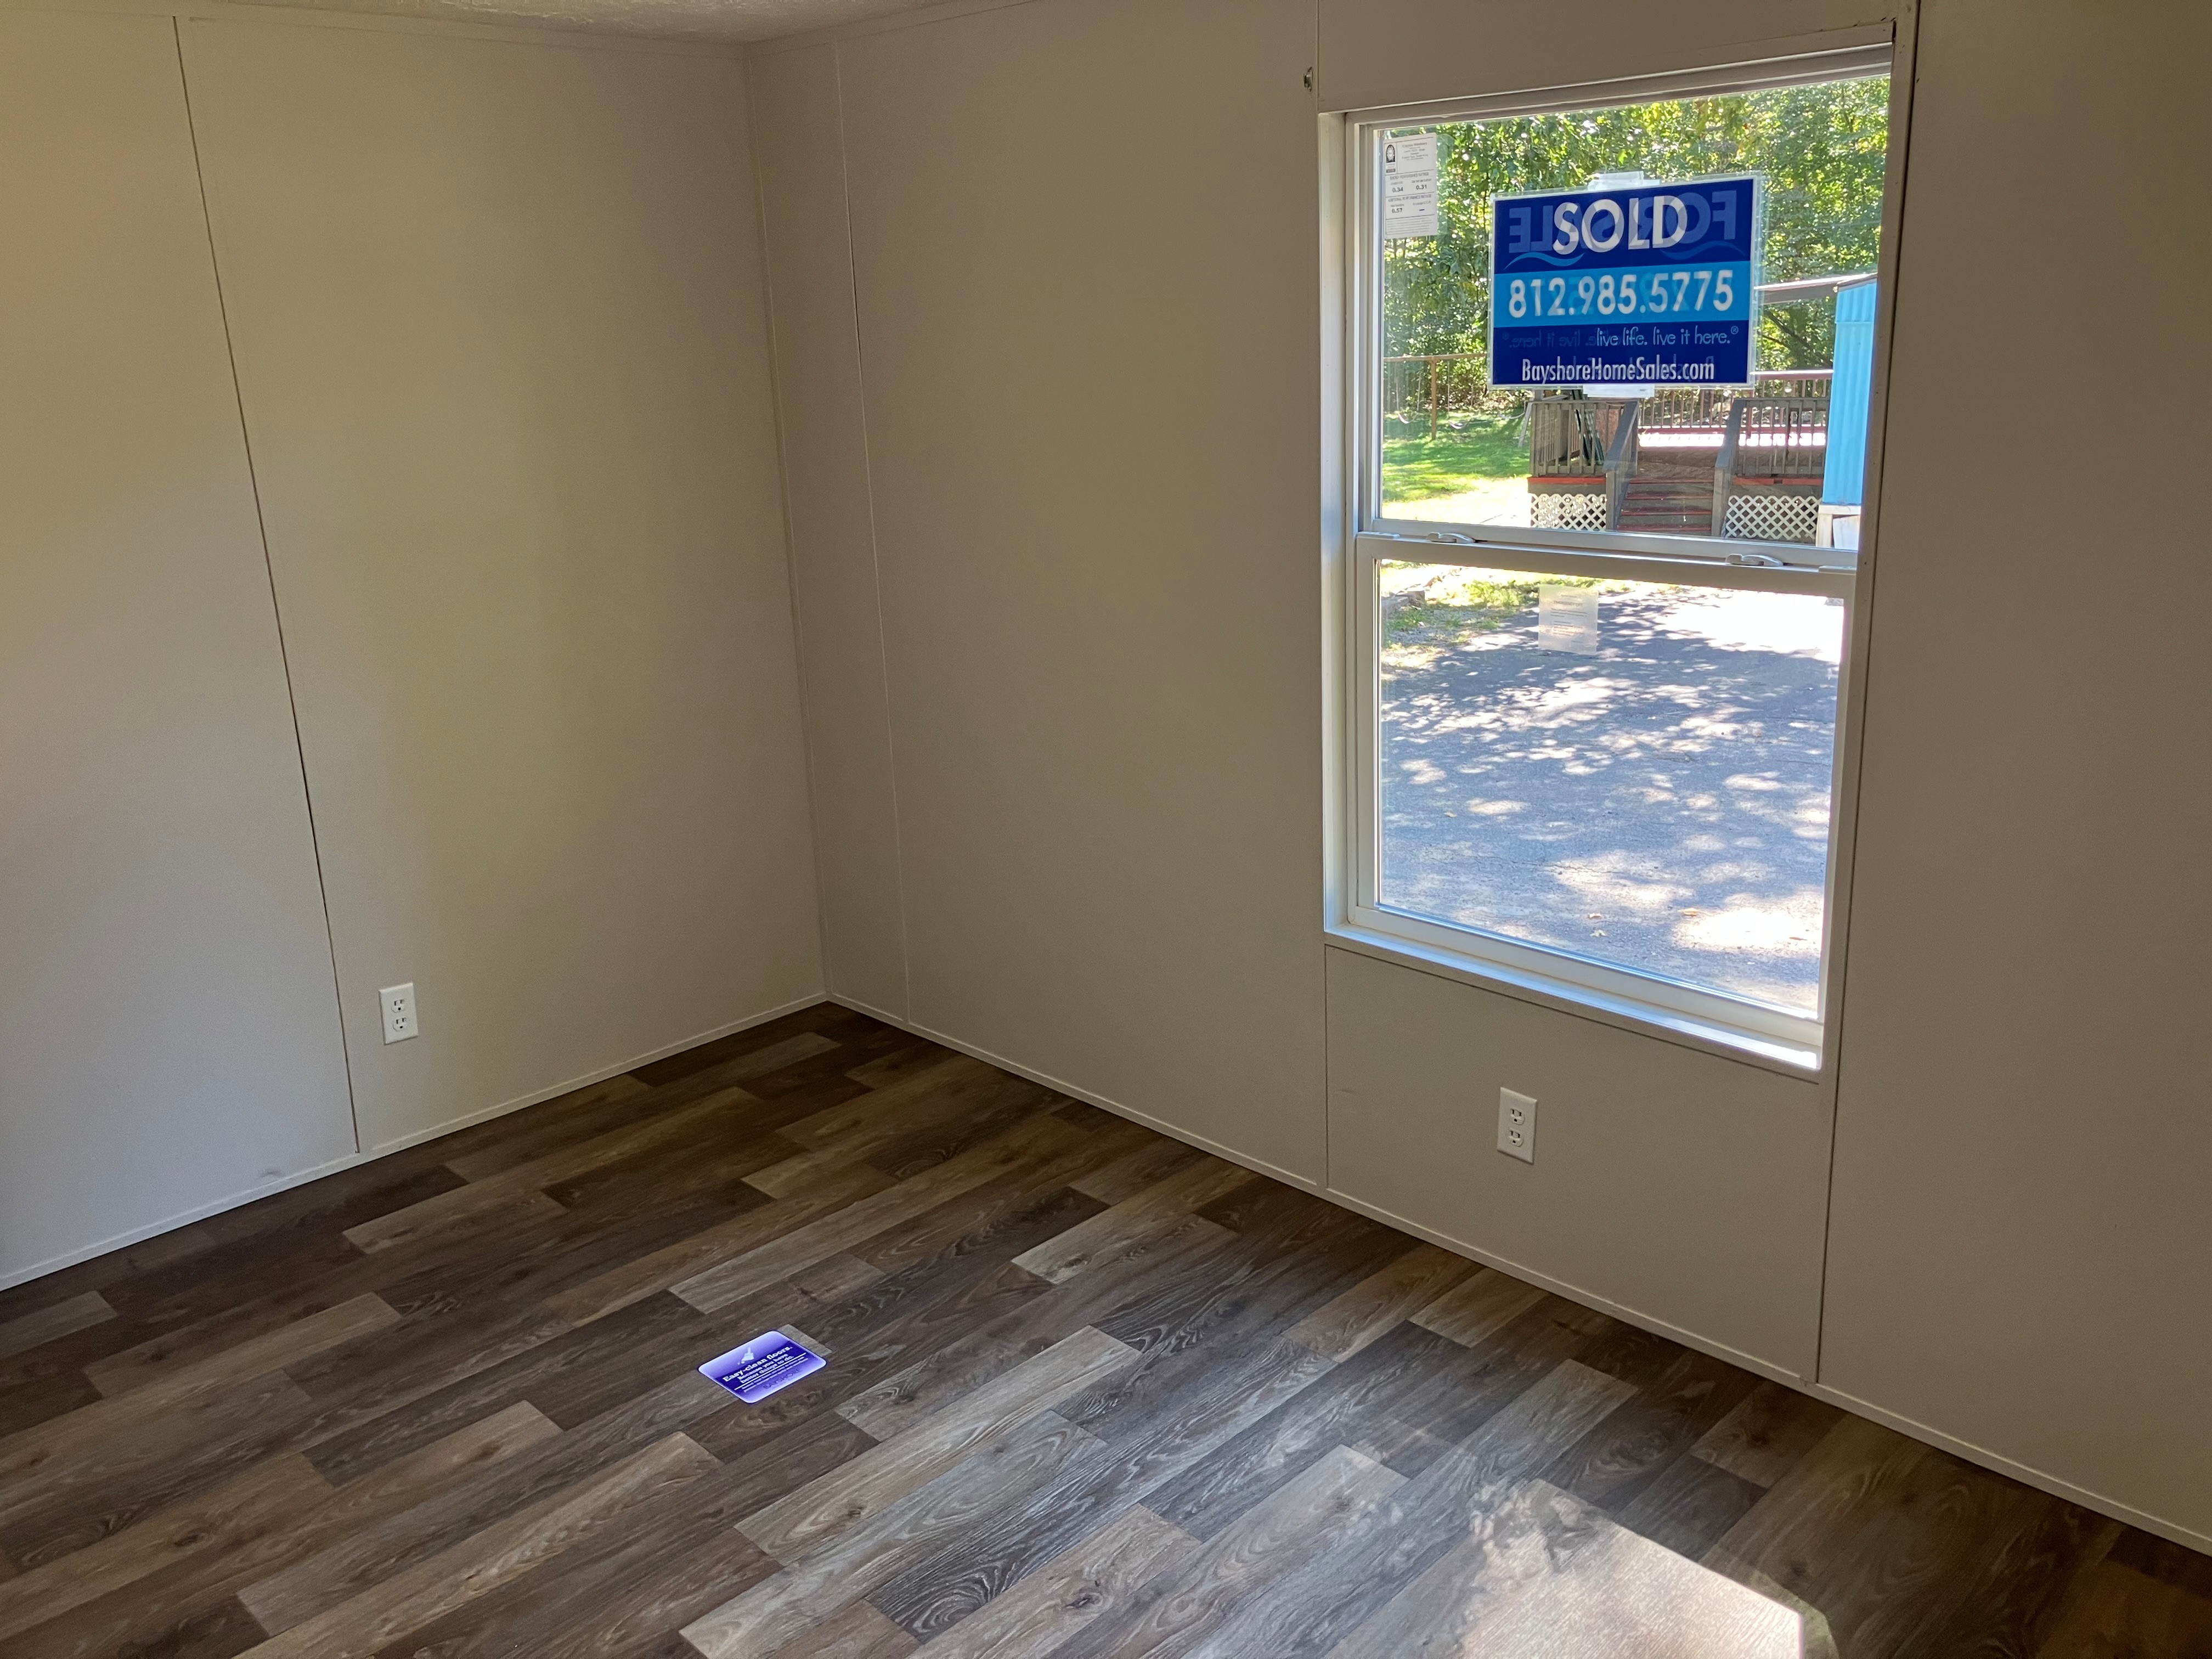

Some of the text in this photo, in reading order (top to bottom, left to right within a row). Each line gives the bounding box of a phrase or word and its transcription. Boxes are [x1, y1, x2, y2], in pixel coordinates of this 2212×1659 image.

[1552, 195, 1688, 255] SOLD
[1508, 269, 1734, 318] 812.985.5775
[1596, 328, 1619, 346] live
[1623, 326, 1647, 346] life.
[1653, 326, 1675, 346] live
[1680, 328, 1690, 345] it
[1522, 354, 1714, 383] BayshoreHomeSales.com
[722, 1358, 768, 1382] Easy-clean
[766, 1346, 793, 1360] floors.
